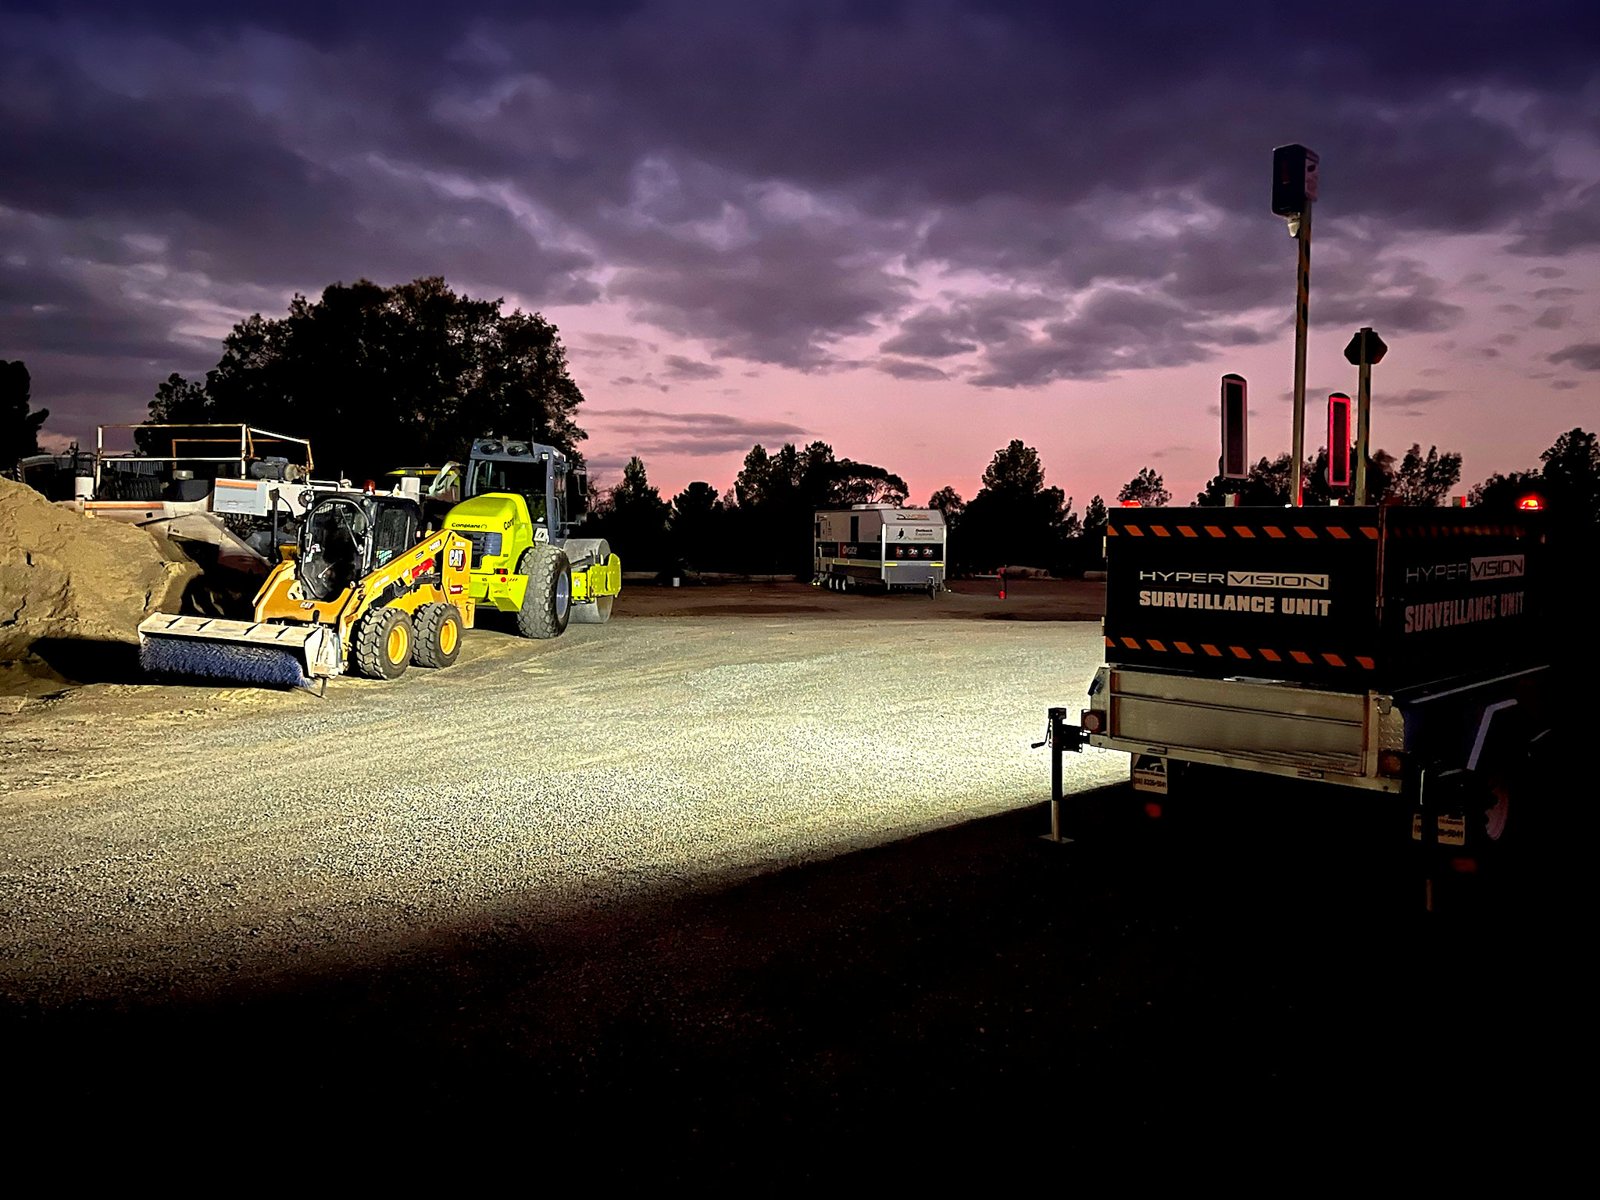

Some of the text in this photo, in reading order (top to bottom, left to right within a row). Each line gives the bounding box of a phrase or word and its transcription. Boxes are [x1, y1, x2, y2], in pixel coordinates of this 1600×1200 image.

[448, 549, 464, 567] CAT
[1138, 589, 1332, 617] SURVEILLANCE UNIT
[1403, 591, 1525, 634] SURVEILLANCE UNIT
